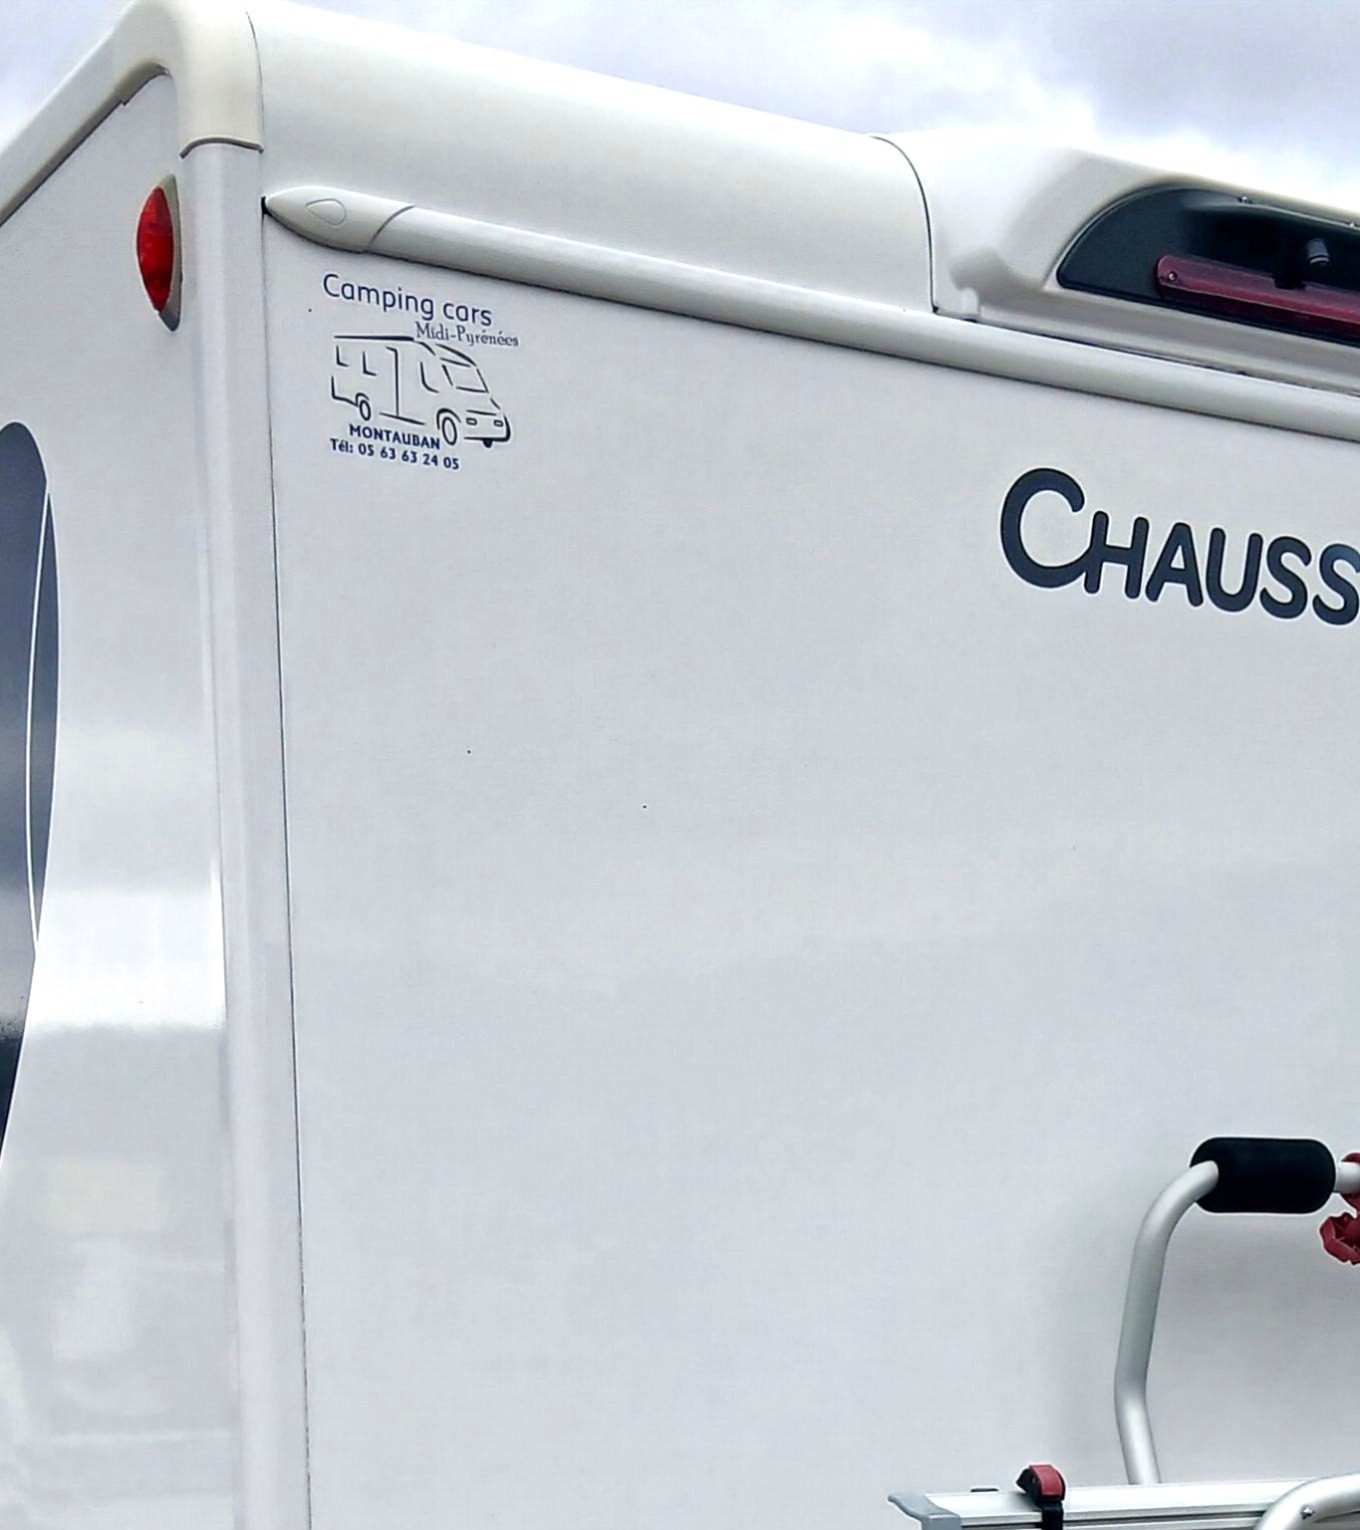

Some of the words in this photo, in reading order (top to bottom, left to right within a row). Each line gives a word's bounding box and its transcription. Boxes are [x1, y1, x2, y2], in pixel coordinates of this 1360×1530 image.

[323, 273, 434, 321] Camping
[443, 302, 492, 326] cars
[415, 321, 519, 347] Midi-Pyrénées
[349, 423, 440, 450] MONTAUBAN
[330, 438, 353, 453] Tél:
[358, 443, 374, 456] 05
[380, 446, 396, 460] 63
[402, 450, 417, 463] 63
[422, 453, 438, 466] 24
[443, 456, 459, 470] 05
